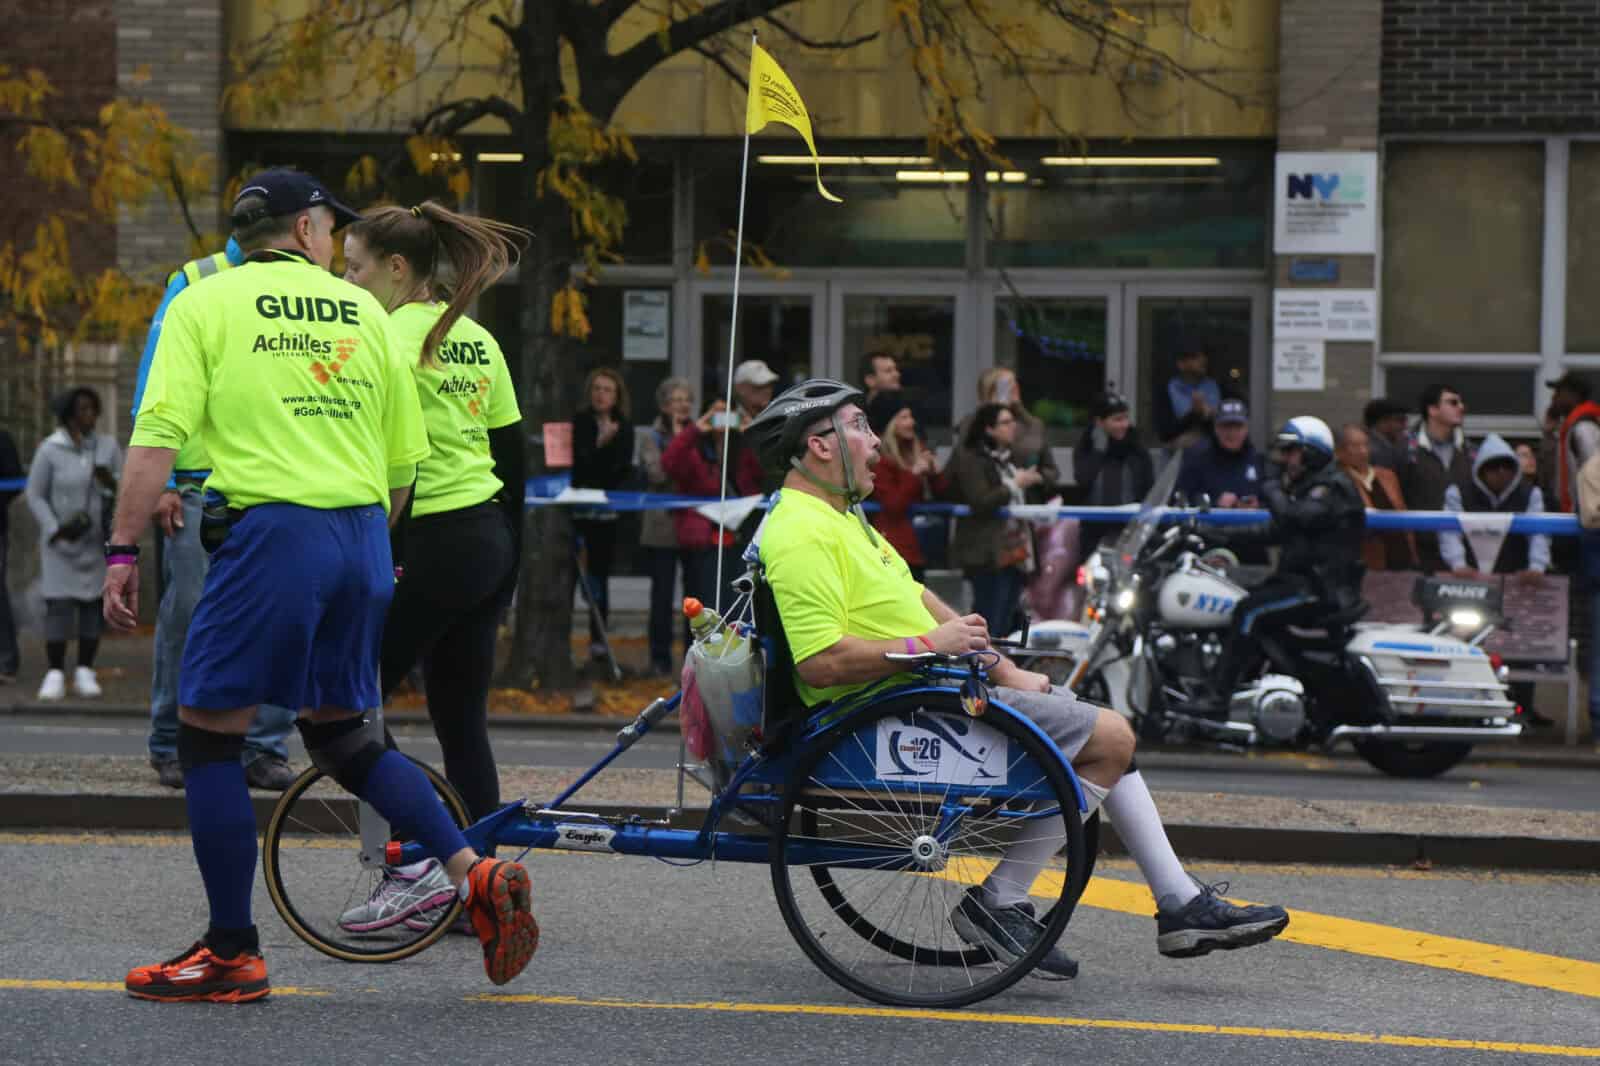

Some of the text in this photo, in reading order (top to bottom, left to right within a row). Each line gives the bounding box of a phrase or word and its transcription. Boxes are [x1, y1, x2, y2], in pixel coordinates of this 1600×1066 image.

[255, 294, 361, 326] GUIDE
[252, 332, 332, 354] Achilles
[294, 406, 353, 420] #GoAilles!
[1437, 583, 1488, 598] POLICE
[1193, 592, 1234, 613] NYP
[911, 737, 941, 760] 126
[565, 829, 606, 845] Eagle
